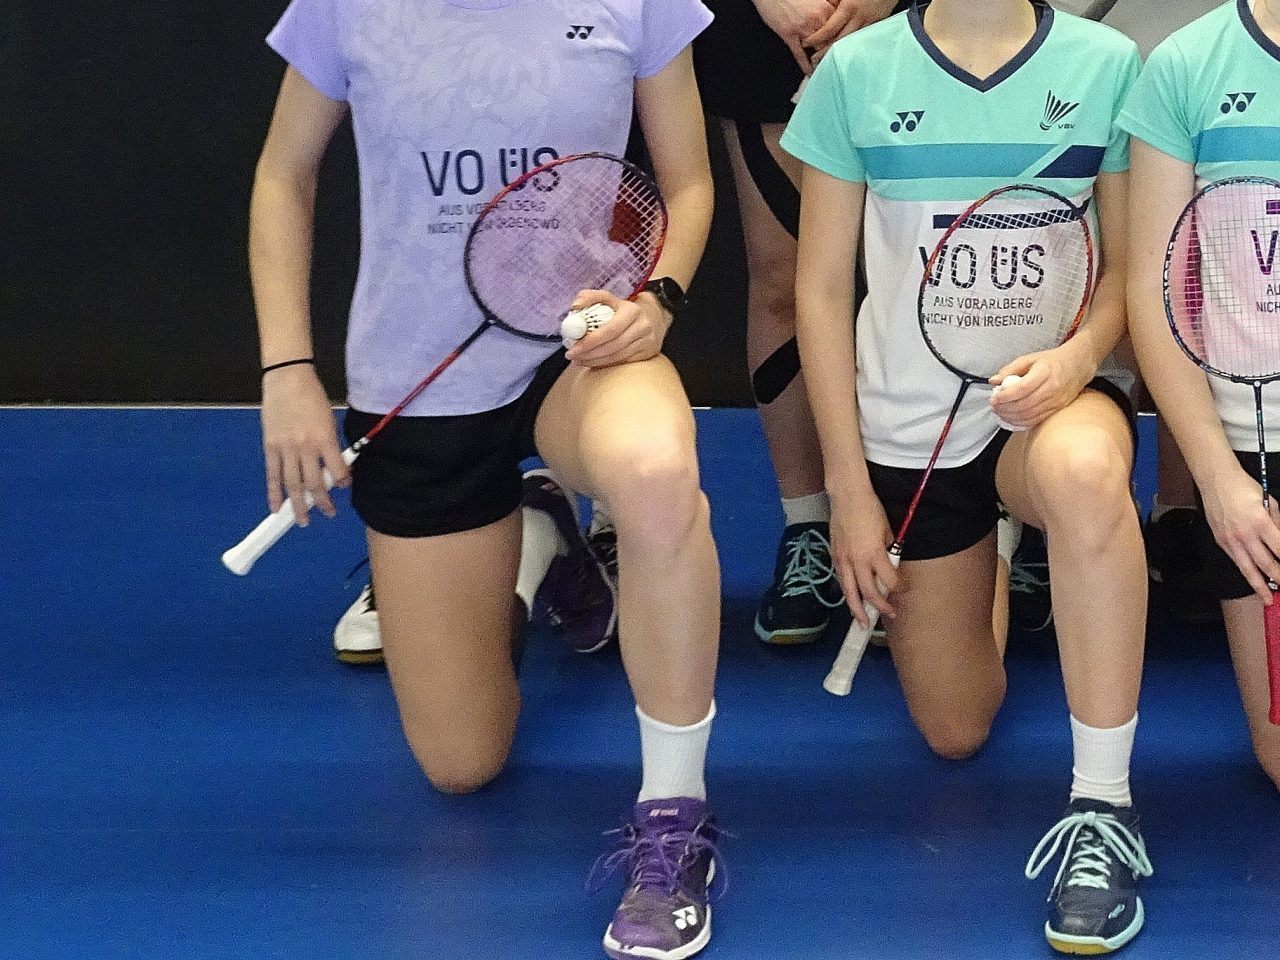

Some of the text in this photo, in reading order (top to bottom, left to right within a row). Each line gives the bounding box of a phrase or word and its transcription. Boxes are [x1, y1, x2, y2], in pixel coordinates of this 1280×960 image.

[420, 147, 560, 197] VO ÜS
[918, 244, 1045, 290] VO ÜS
[933, 296, 1032, 310] AUS VORARLBERG
[922, 313, 1043, 327] NICHT VON IRGENDWO
